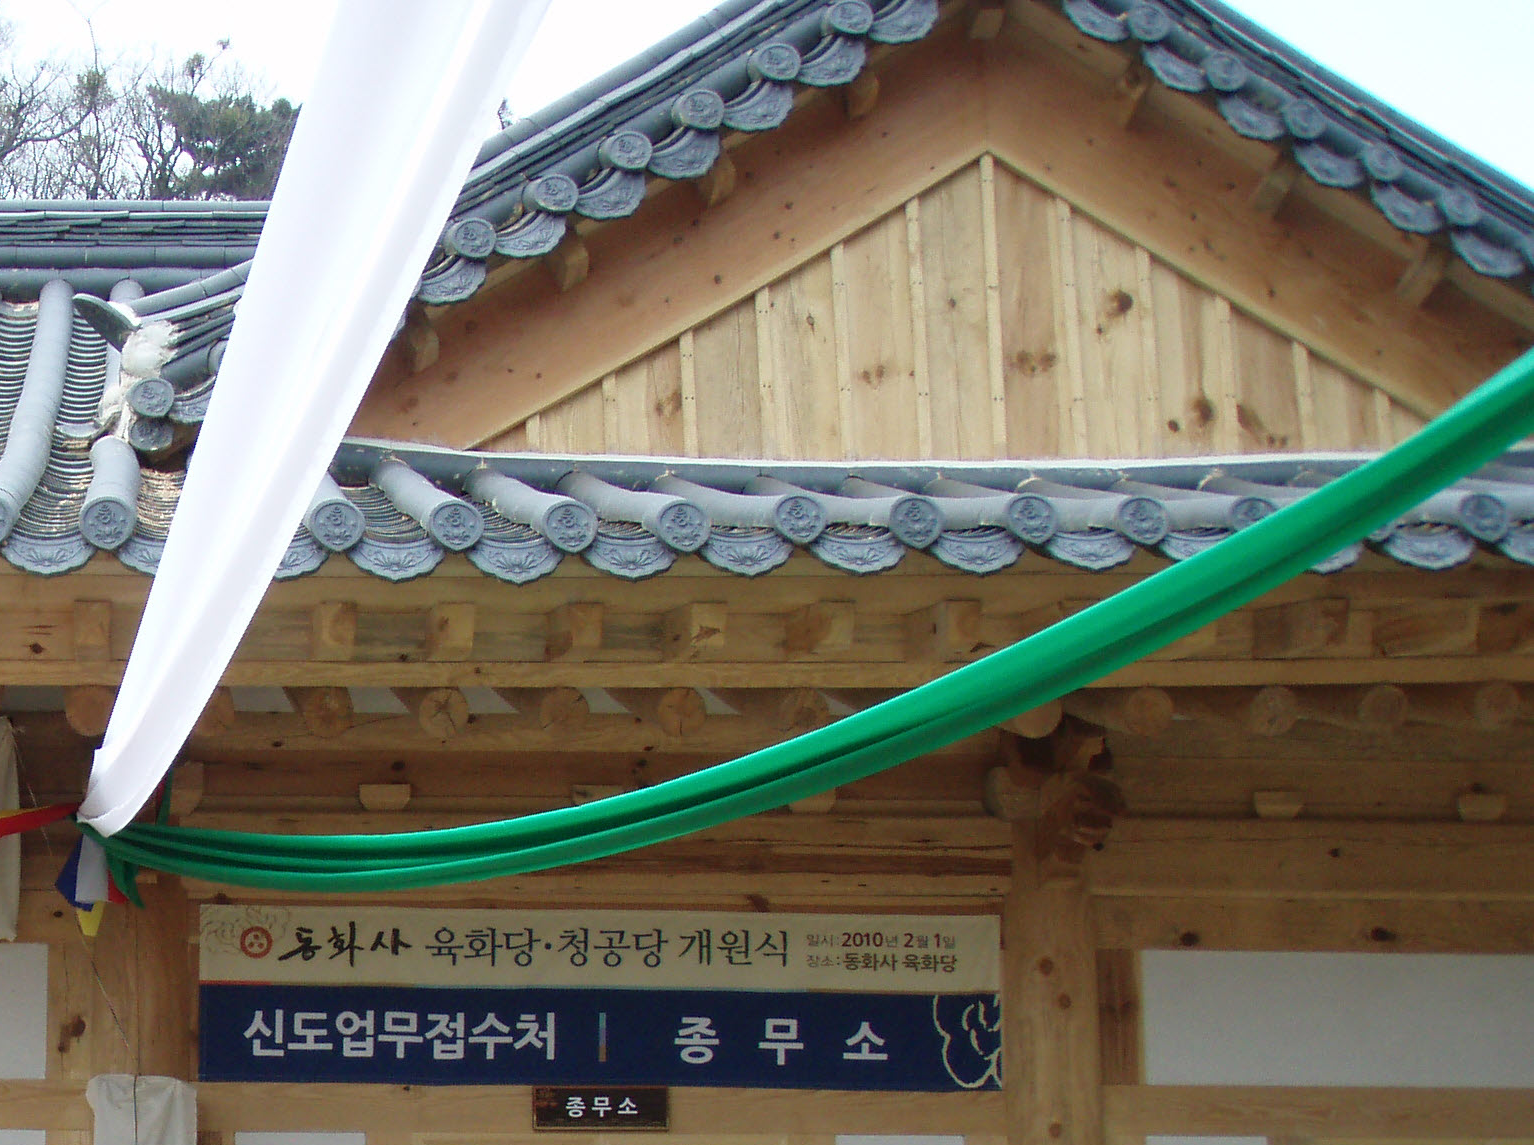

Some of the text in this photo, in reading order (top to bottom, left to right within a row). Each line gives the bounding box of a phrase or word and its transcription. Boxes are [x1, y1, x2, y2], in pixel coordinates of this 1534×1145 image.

[278, 921, 412, 967] 동화사
[679, 928, 788, 967] 개원식
[904, 932, 928, 949] 2월
[933, 933, 956, 949] 1일
[902, 954, 957, 973] 육화당
[243, 1009, 555, 1060] 신도업무접수처
[565, 1096, 639, 1118] 종무소
